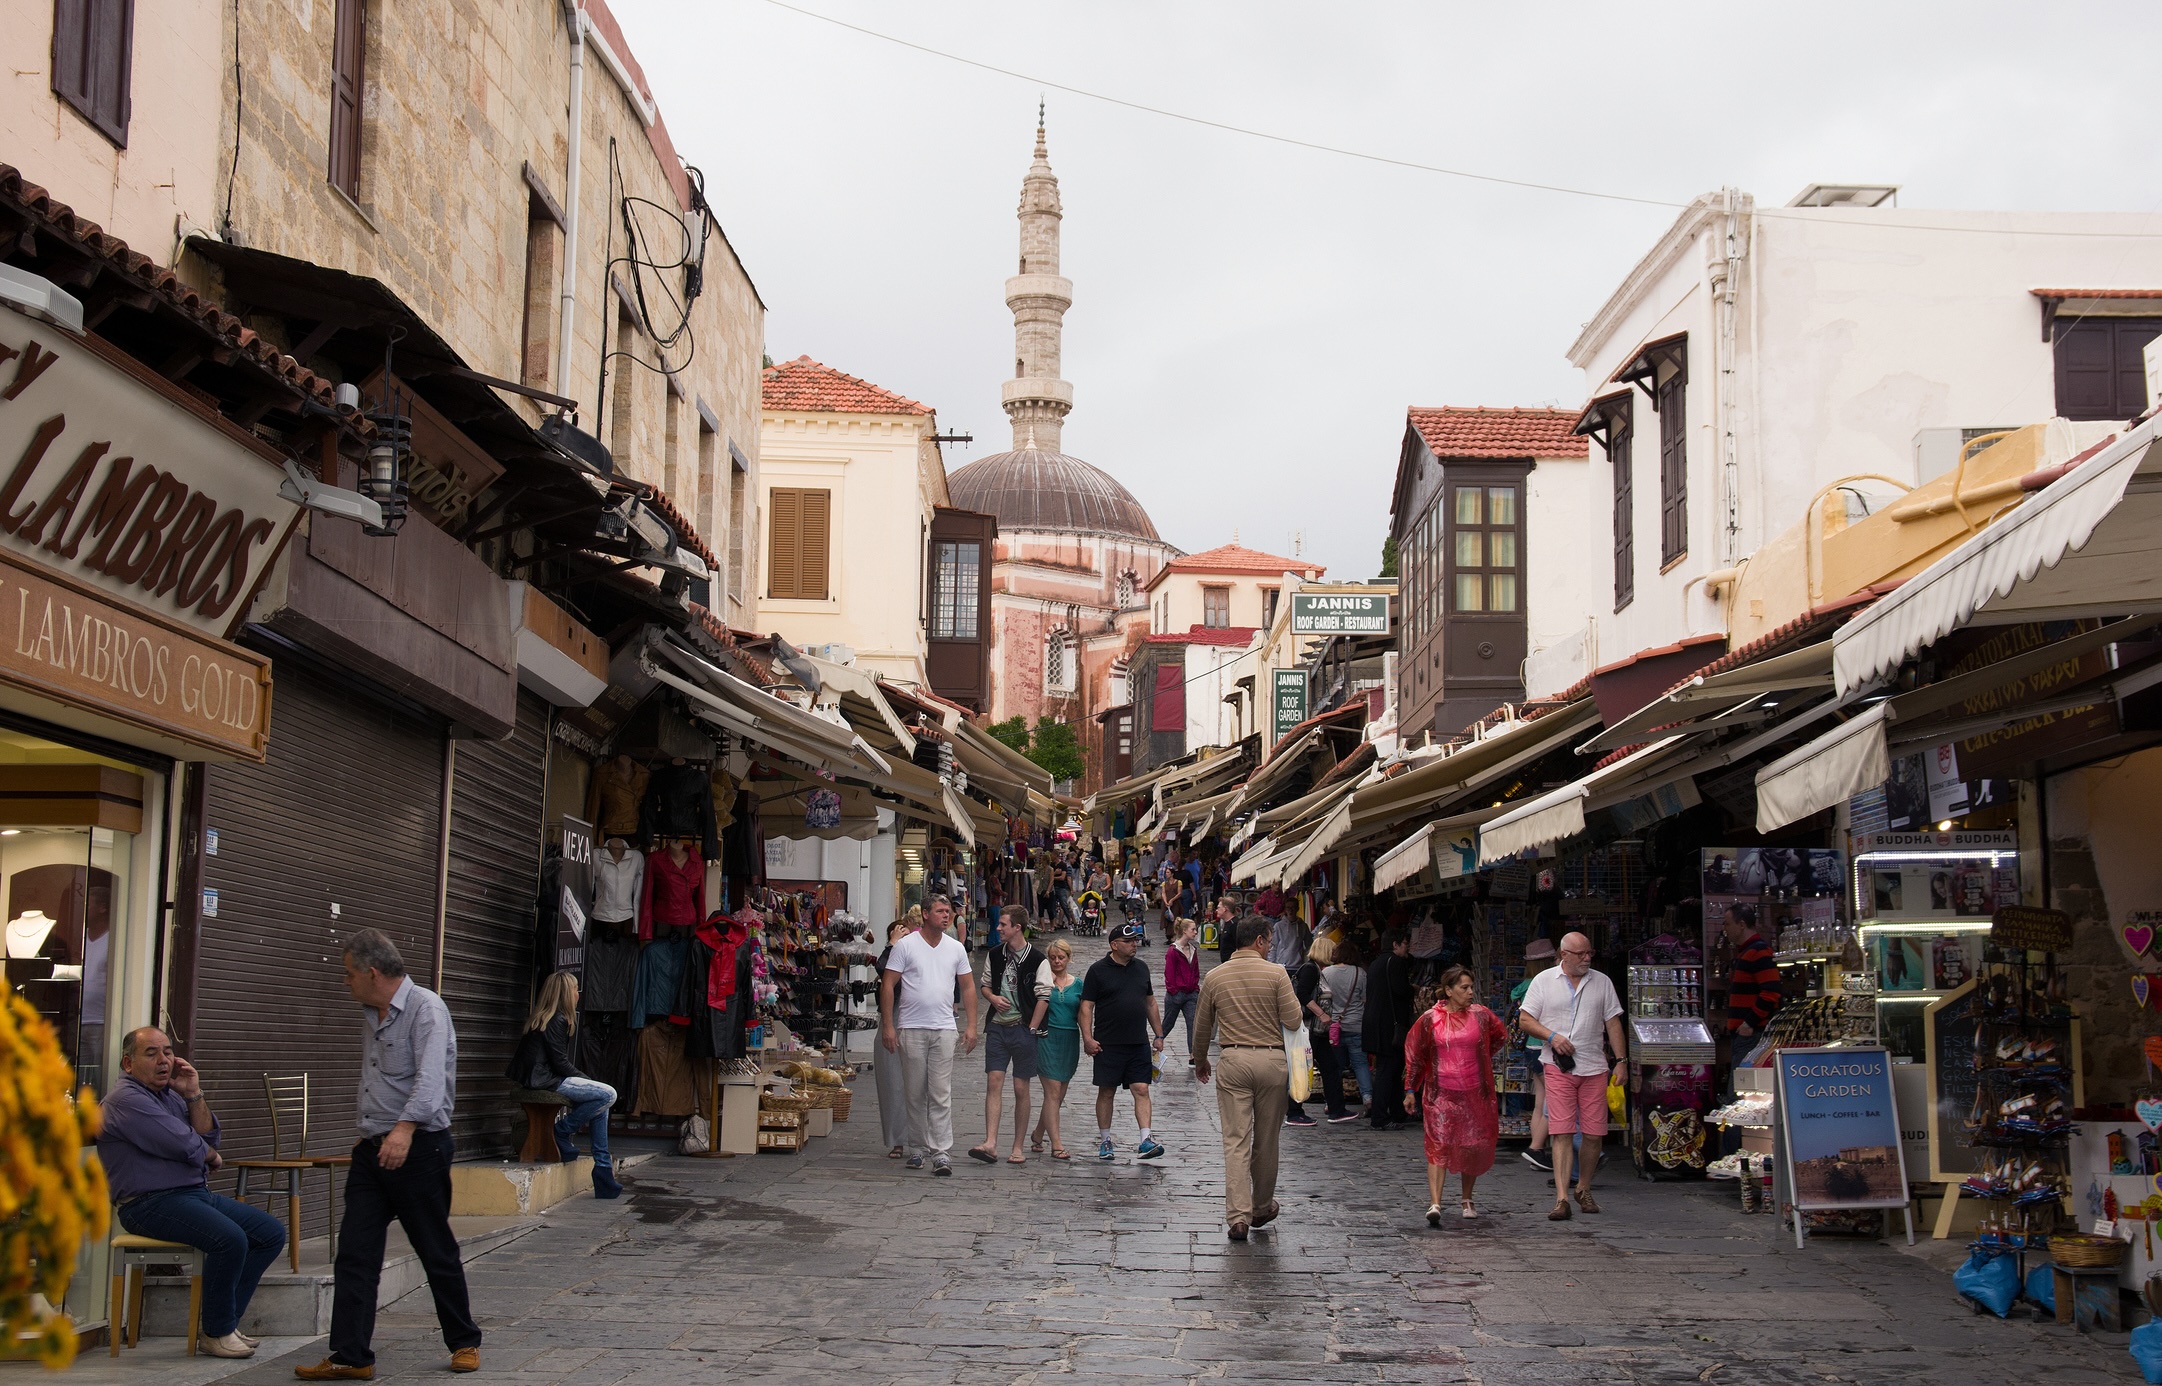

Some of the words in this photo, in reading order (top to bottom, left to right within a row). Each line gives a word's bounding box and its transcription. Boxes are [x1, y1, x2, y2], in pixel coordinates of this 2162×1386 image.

[0, 413, 275, 619] LAMBROS
[1306, 598, 1373, 610] JANNIS
[1296, 616, 1314, 630] ROOF
[1315, 616, 1340, 630] GARDEN
[1344, 616, 1384, 630] RESTAURANT
[15, 587, 170, 705] LAMBROS
[181, 654, 257, 731] GOLD
[1950, 631, 2013, 678] ΟΚΡΑΤΟΥΣ
[1278, 674, 1304, 686] JANNIS
[1282, 696, 1299, 708] ROOF
[1278, 709, 1303, 722] GARDEN
[1876, 835, 1932, 845] BUDDHA
[1955, 834, 2011, 844] BUDDHA
[1660, 1067, 1688, 1076] Charms
[1689, 1068, 1699, 1079] of
[1790, 1063, 1882, 1078] SOCRATOUS
[1649, 1080, 1710, 1092] TREASURE
[1805, 1084, 1871, 1098] GARDEN
[1800, 1112, 1826, 1120] LUNCH
[1832, 1111, 1859, 1119] COFFEE
[1865, 1110, 1881, 1118] BAR
